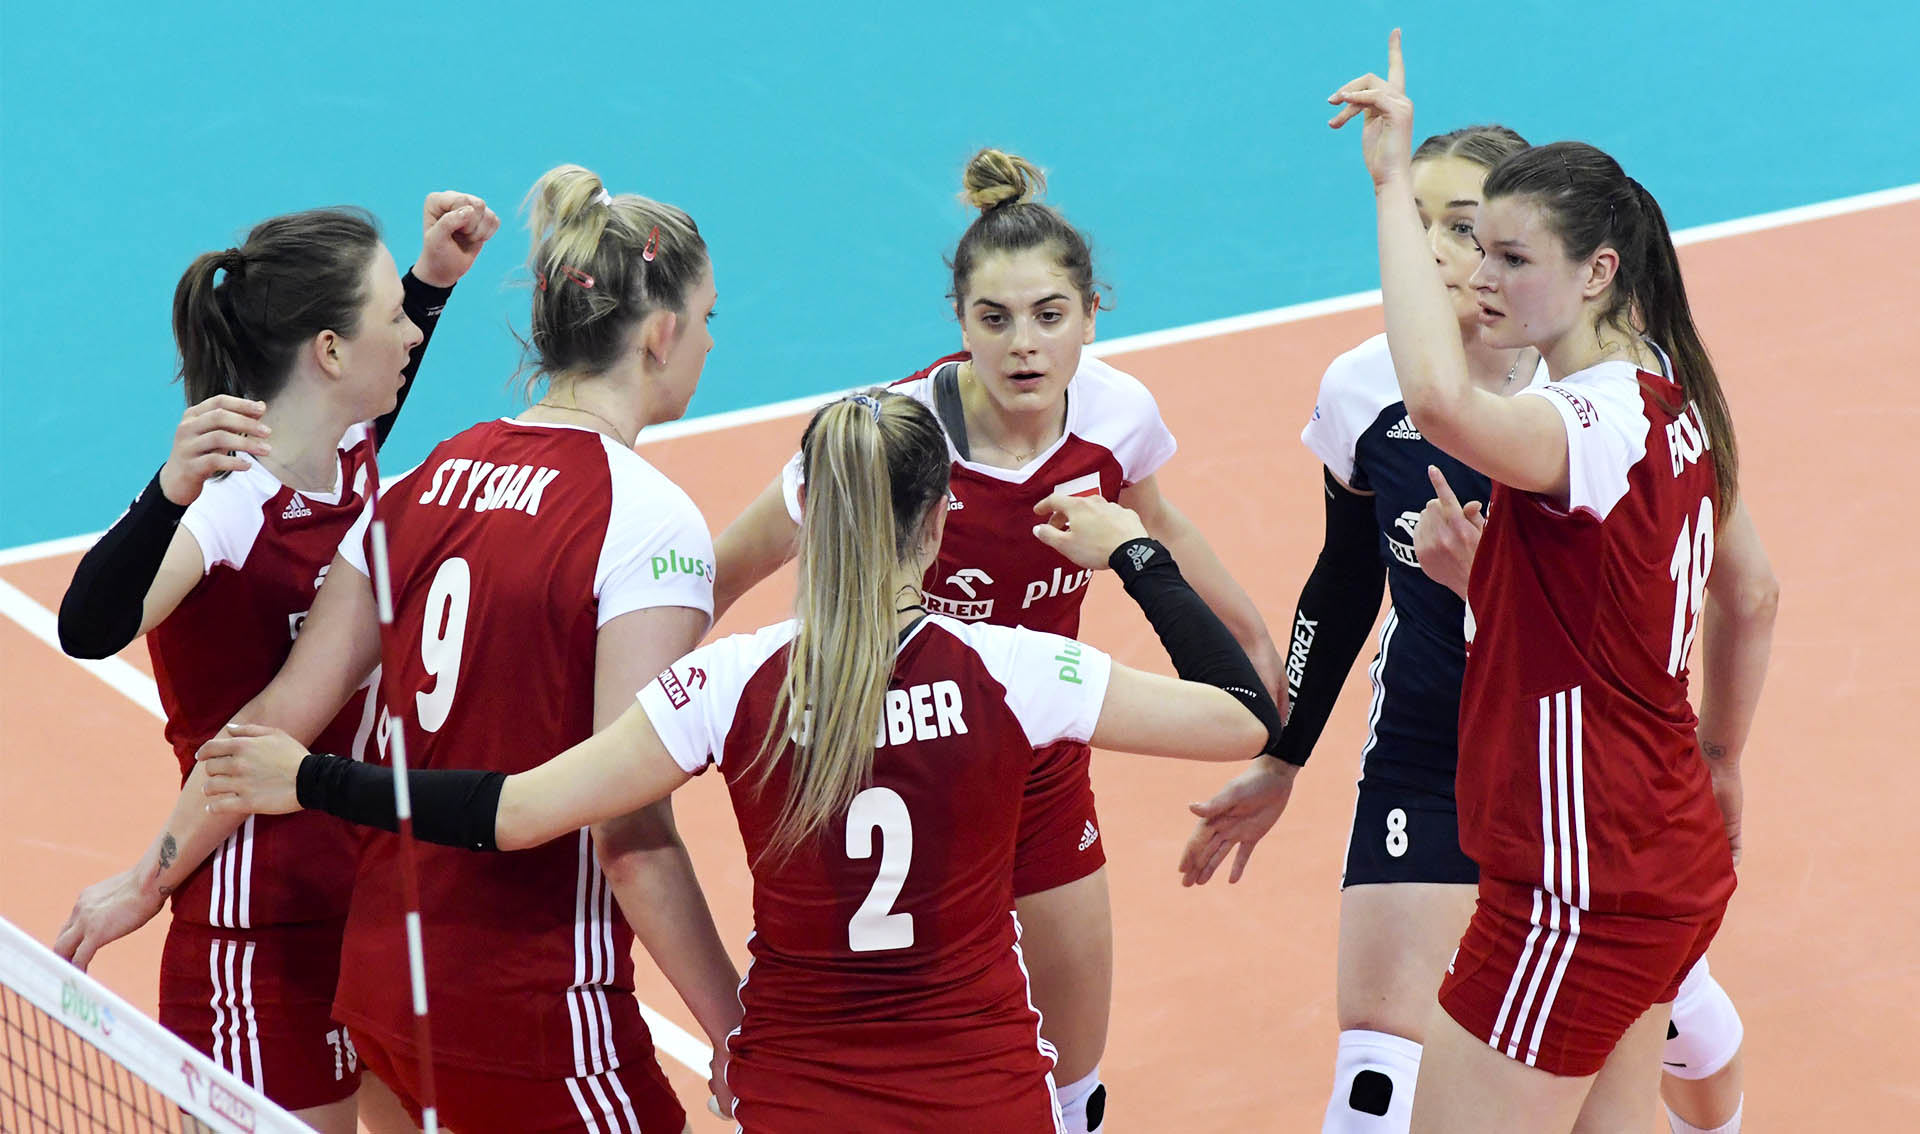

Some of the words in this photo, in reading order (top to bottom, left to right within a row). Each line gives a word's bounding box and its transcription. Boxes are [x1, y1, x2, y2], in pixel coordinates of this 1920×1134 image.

[1386, 429, 1421, 440] adidas
[418, 458, 560, 516] STYSIAK
[282, 508, 312, 520] adidas
[651, 549, 704, 580] plus
[1667, 496, 1714, 678] 19
[416, 556, 471, 733] 9
[658, 668, 689, 708] ORLEN
[1385, 808, 1408, 857] 8
[845, 786, 915, 952] 2
